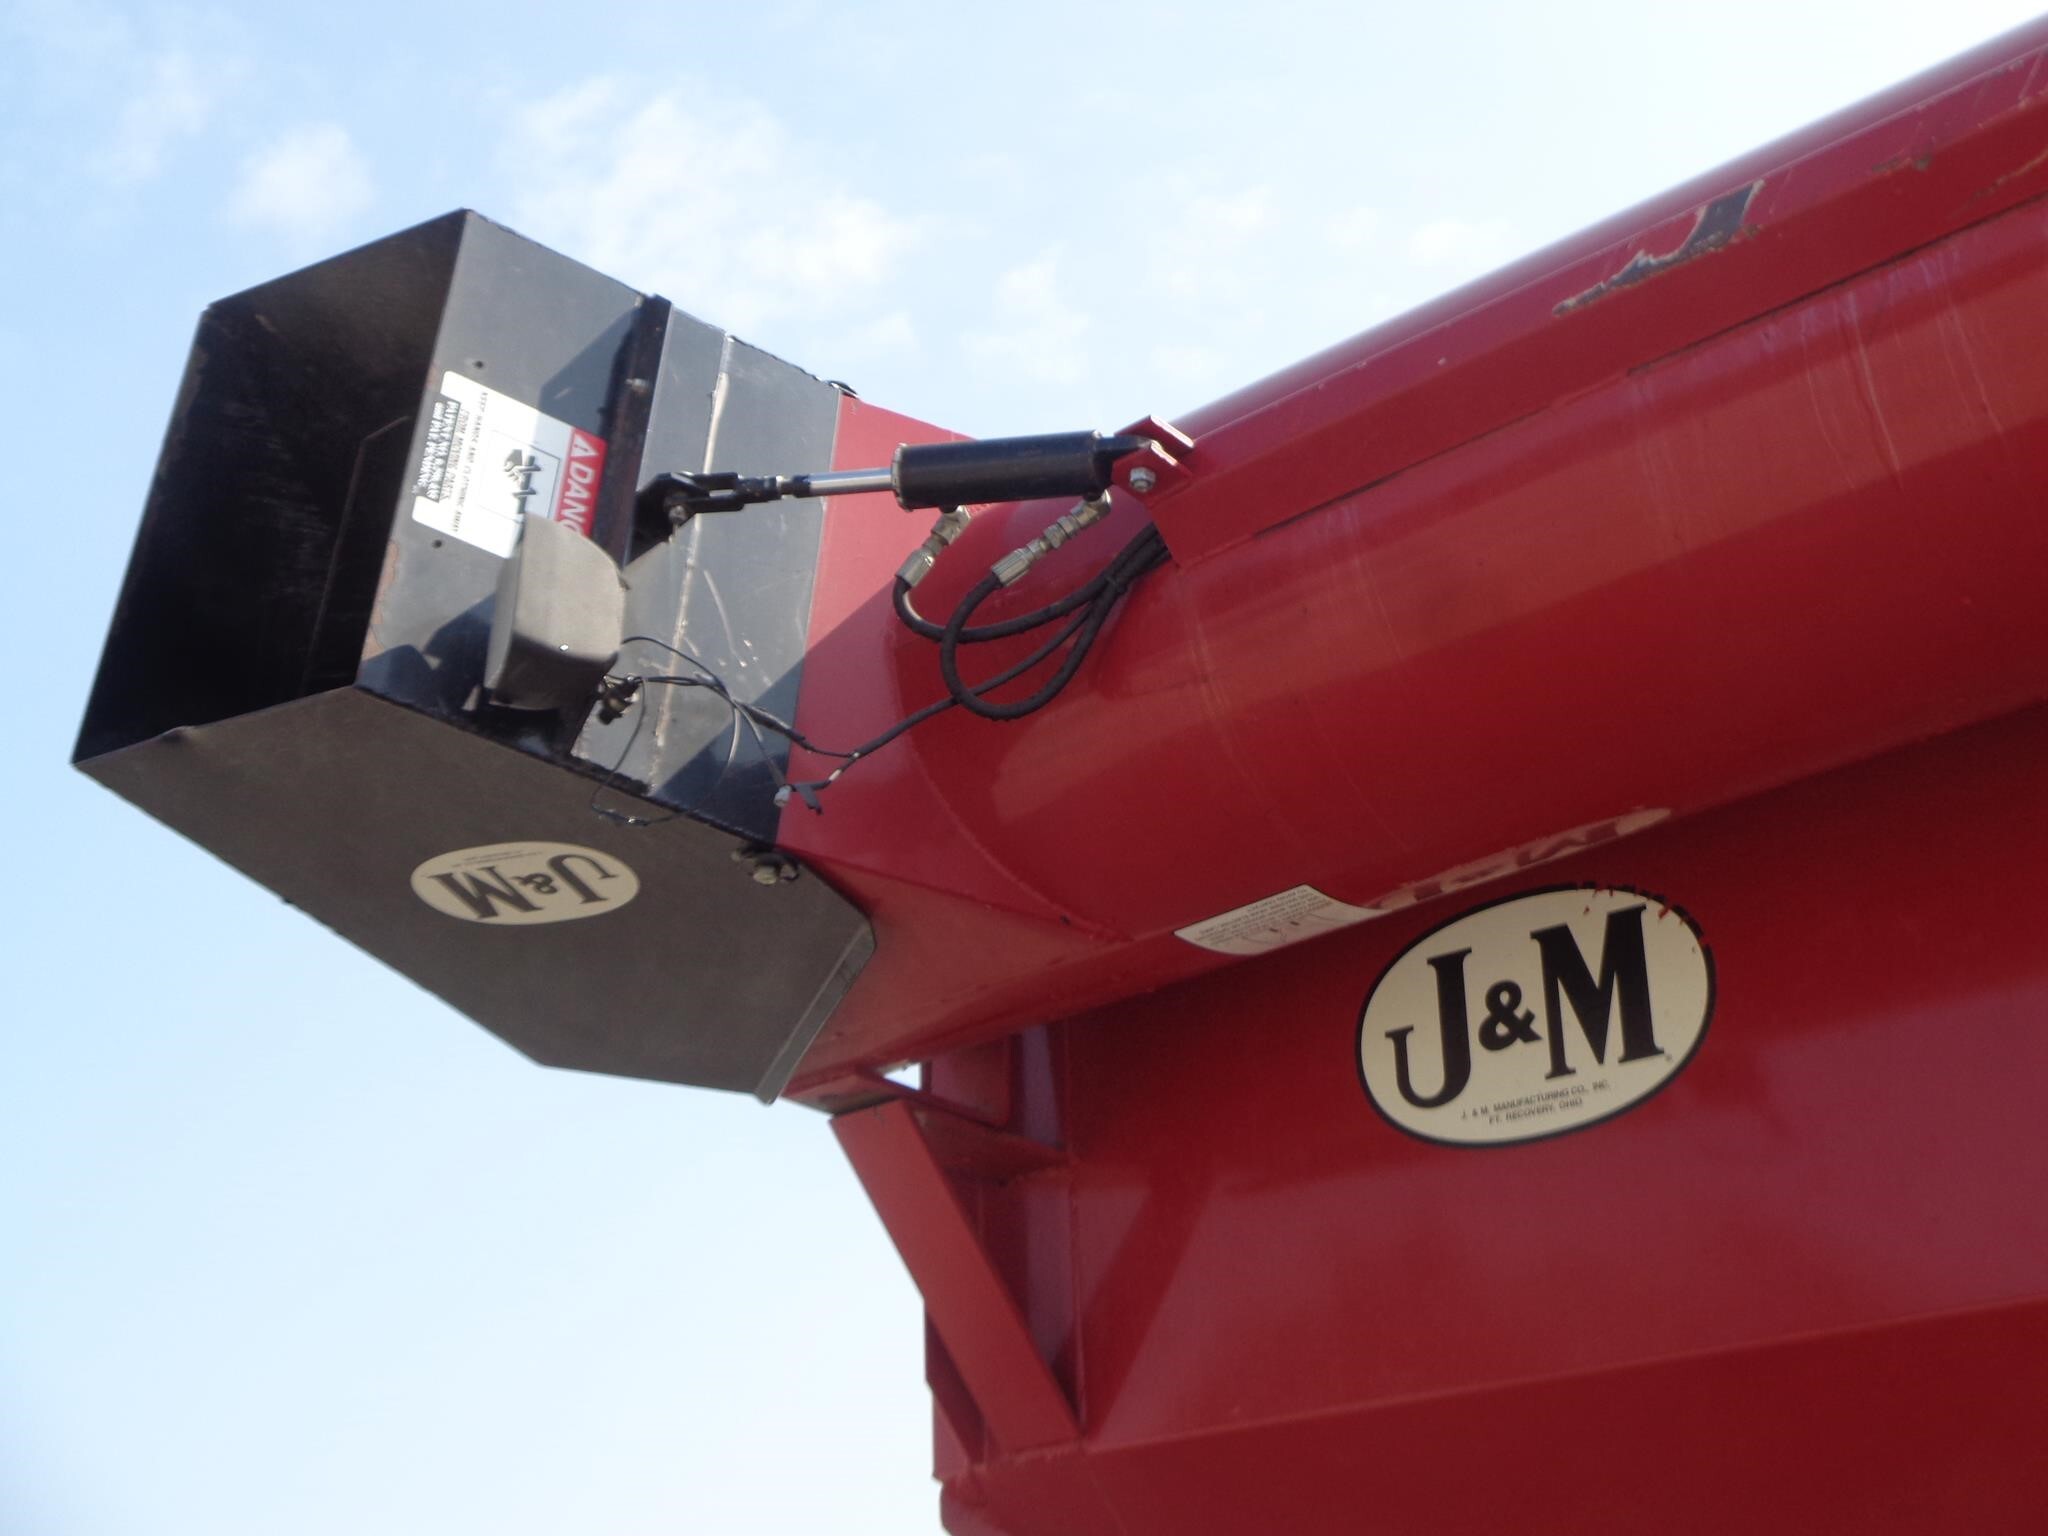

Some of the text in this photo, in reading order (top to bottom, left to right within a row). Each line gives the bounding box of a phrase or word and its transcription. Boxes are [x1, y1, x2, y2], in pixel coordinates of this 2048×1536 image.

[427, 854, 619, 919] J&M
[1385, 904, 1664, 1108] J&M
[1493, 1087, 1569, 1112] MANUFACTURING
[1559, 1097, 1583, 1110] OHIO
